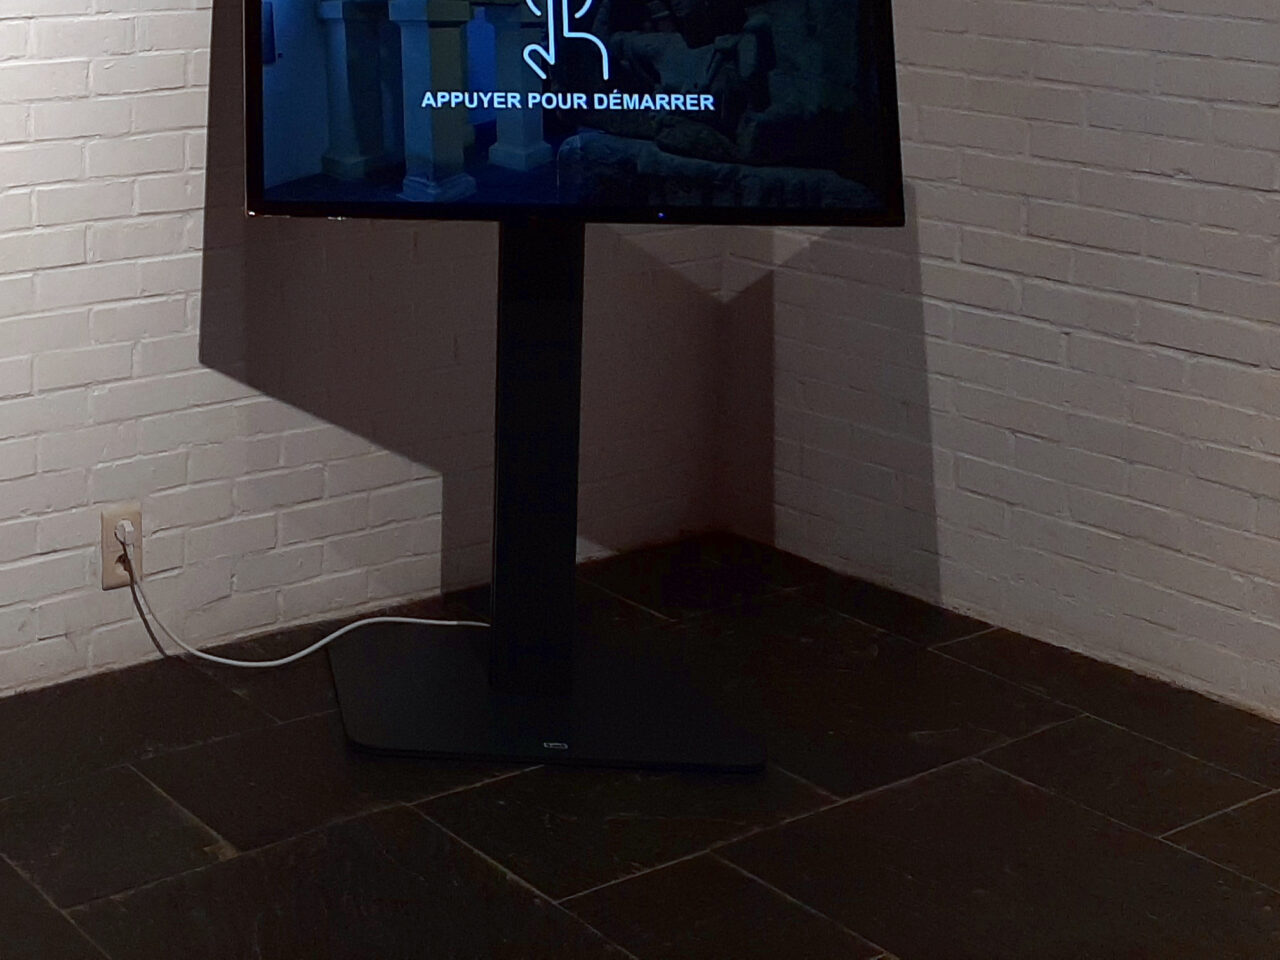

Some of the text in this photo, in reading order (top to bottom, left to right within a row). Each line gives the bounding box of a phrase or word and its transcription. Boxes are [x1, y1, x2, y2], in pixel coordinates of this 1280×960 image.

[421, 89, 715, 111] APPUYER POUR DÉMARRER
